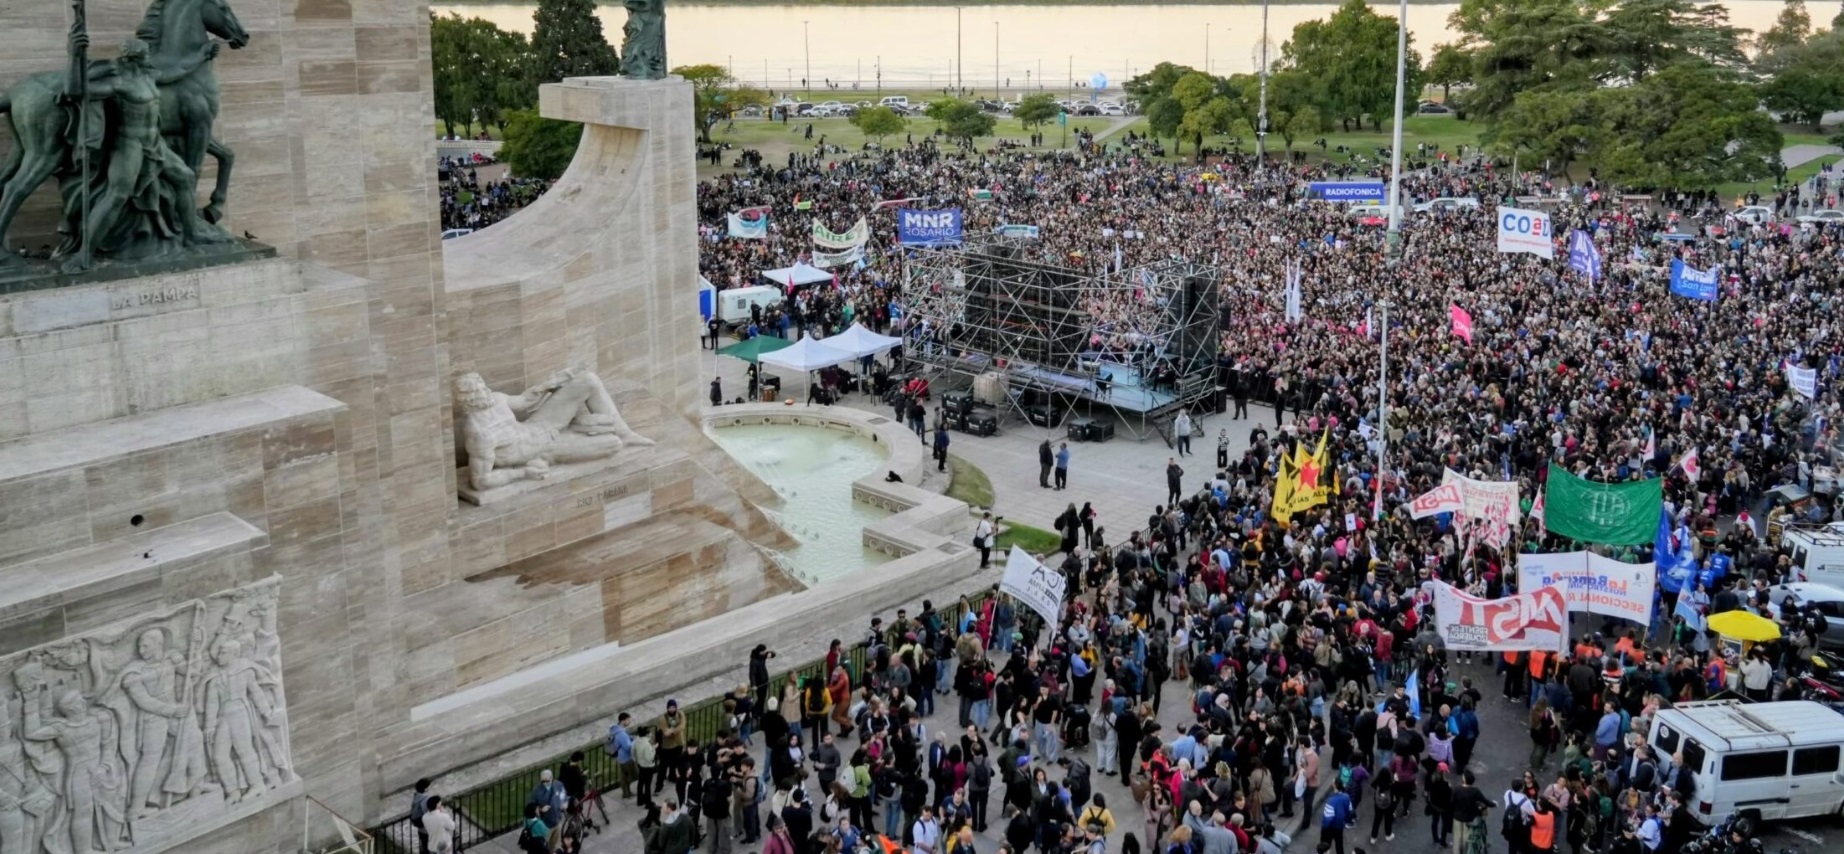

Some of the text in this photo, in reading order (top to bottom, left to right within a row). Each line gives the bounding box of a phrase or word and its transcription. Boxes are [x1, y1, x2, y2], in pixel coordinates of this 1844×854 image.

[1325, 188, 1382, 196] RADIOFONICA
[904, 212, 954, 228] MNR
[905, 227, 955, 236] ROSARIO
